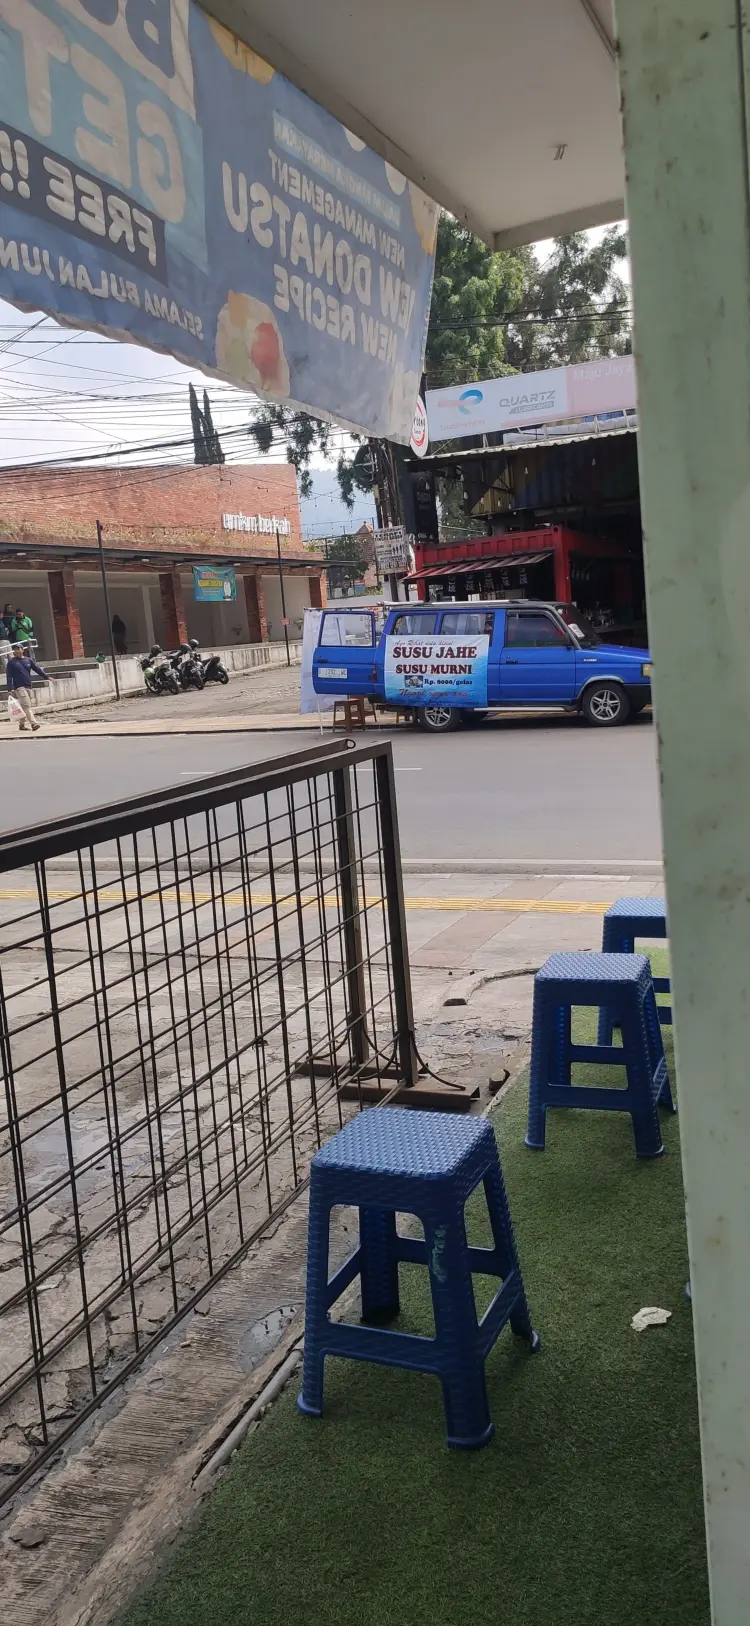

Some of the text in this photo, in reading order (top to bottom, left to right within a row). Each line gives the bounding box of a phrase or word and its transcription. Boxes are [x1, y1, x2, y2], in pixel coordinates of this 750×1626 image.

[574, 368, 602, 383] Maju
[499, 387, 556, 408] QUARTZ
[393, 646, 477, 659] SUSU JAHE
[396, 664, 472, 674] SUSU MURNI
